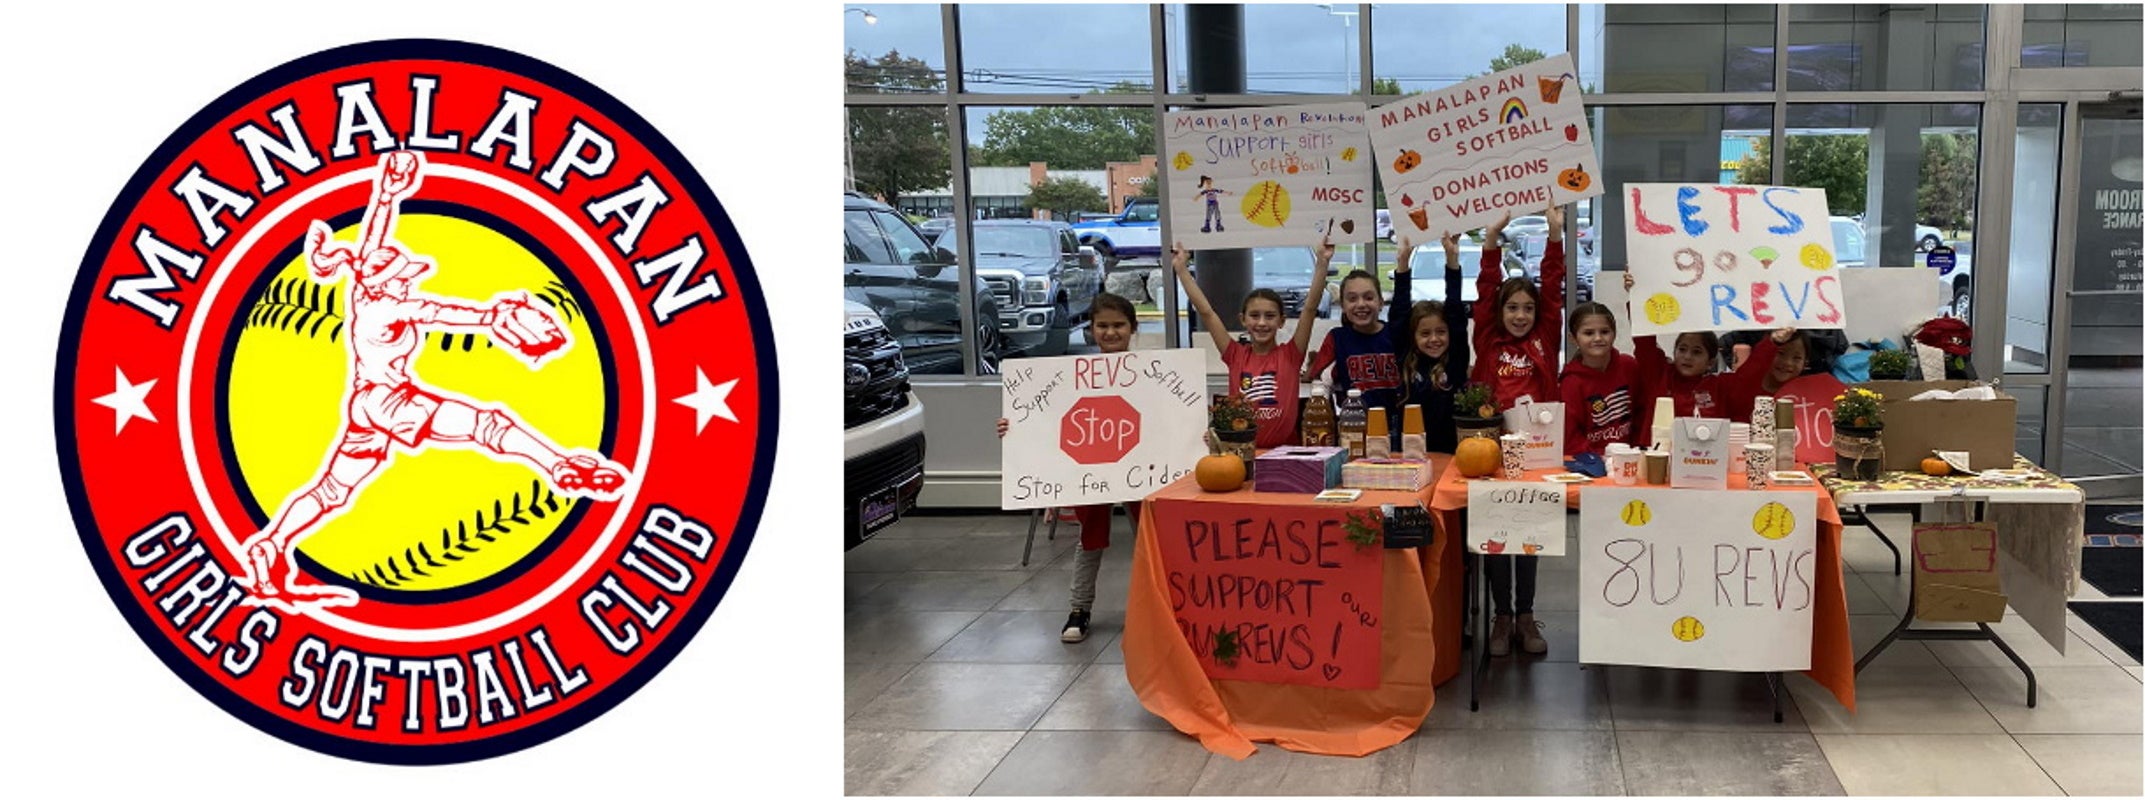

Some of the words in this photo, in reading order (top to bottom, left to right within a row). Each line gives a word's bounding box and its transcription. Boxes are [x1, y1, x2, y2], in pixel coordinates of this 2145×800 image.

[1381, 73, 1526, 129] MANALAPAN
[1298, 132, 1334, 150] girls
[1427, 107, 1490, 143] GIRLS
[1456, 116, 1553, 156] SOFTBALL
[1311, 186, 1364, 204] MGSC
[1432, 158, 1549, 201] DONATIONS
[108, 75, 724, 328] MANALAPAN
[1631, 185, 1806, 238] LETS
[1670, 247, 1738, 288] go
[1709, 275, 1842, 326] REVS
[1003, 366, 1034, 396] Help
[1074, 353, 1139, 391] REVS
[1347, 353, 1400, 381] REVS
[1066, 407, 1136, 451] Stop
[1012, 475, 1064, 501] Stop
[1184, 517, 1344, 569] PLEASE
[1167, 570, 1325, 618] SUPPORT
[1603, 537, 1687, 608] 8U
[1712, 542, 1814, 612] REVS
[122, 512, 280, 678] GIRLS
[280, 628, 590, 732] SOFTBALL
[580, 503, 716, 656] CLUB
[1235, 620, 1315, 671] REVS
